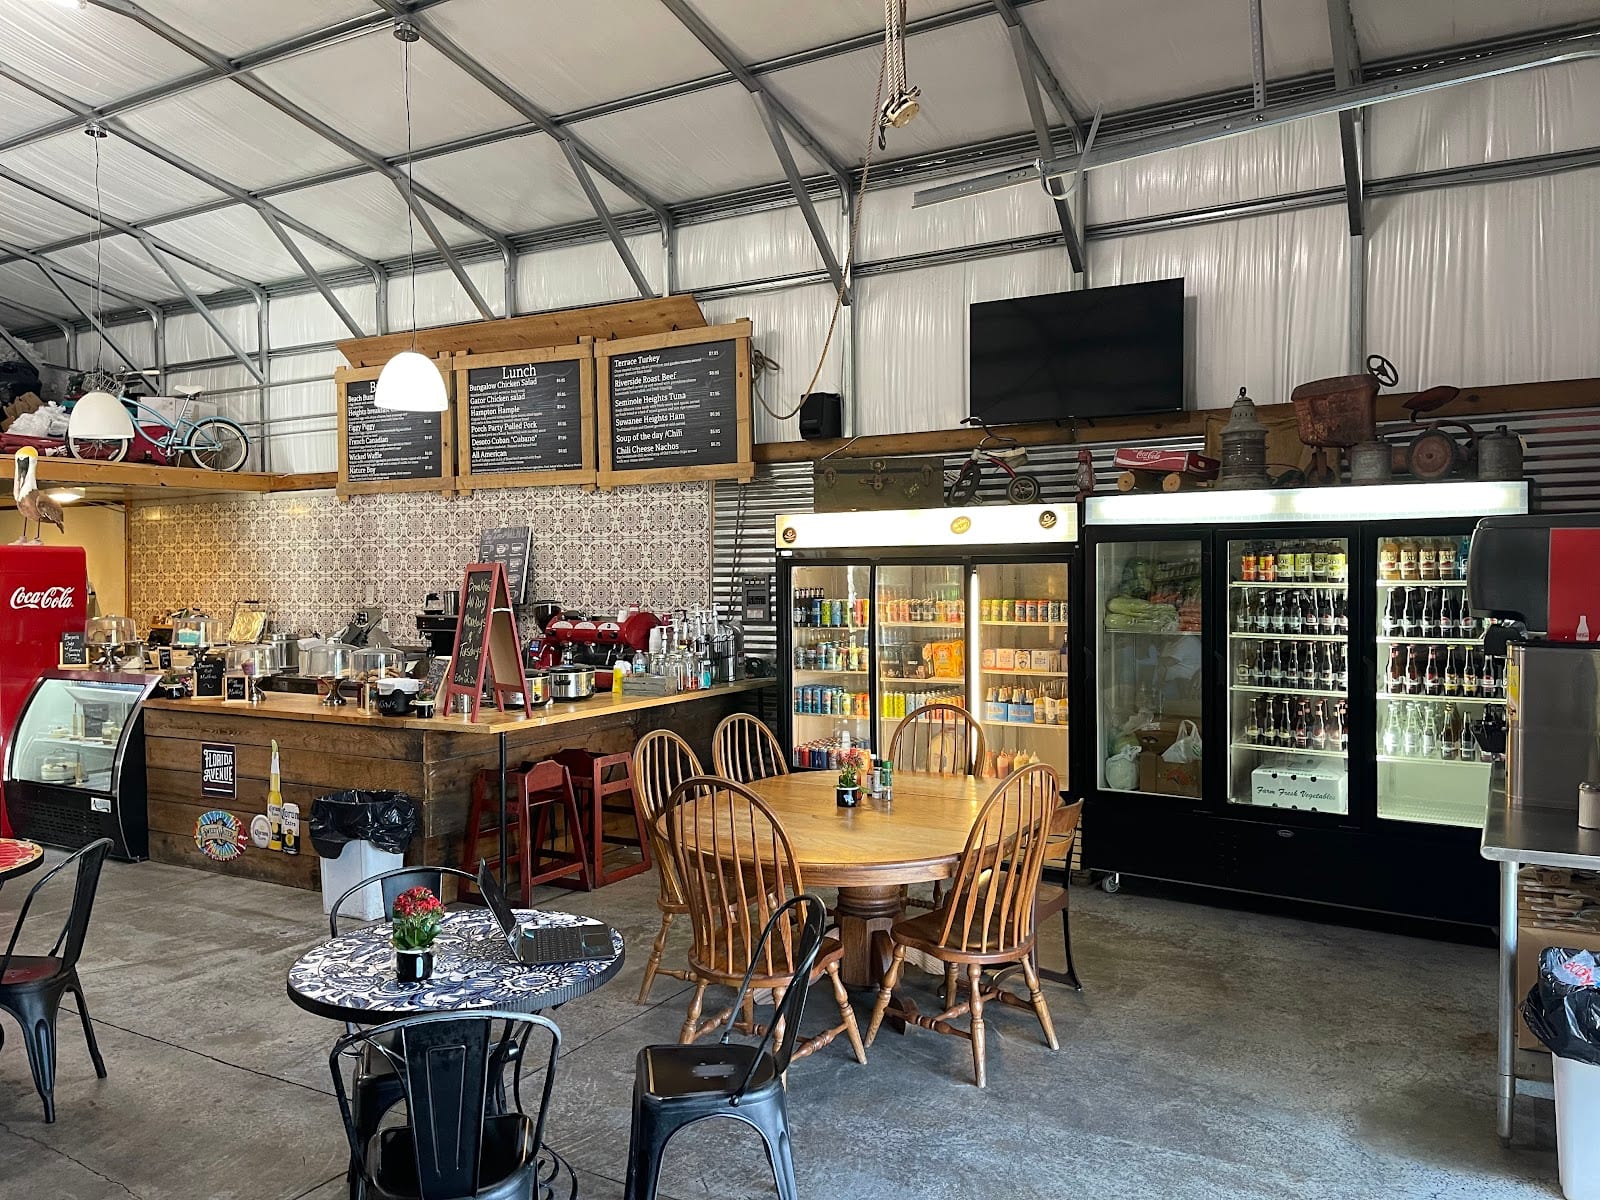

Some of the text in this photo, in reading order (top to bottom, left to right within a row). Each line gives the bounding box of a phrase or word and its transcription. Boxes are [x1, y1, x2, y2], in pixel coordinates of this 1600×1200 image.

[614, 359, 638, 367] Terrace
[638, 354, 660, 364] Turkey
[502, 364, 537, 379] Lunch
[469, 384, 497, 393] Bungalow
[497, 379, 521, 389] Chicken
[521, 377, 538, 386] Salad
[614, 371, 677, 387] Riverside Roast Beef
[469, 397, 486, 405] Gator
[486, 395, 512, 404] Chicken
[510, 393, 526, 401] salad
[615, 392, 687, 407] Seminole Heights Tuna
[470, 407, 497, 417] Hampton
[643, 414, 668, 424] Heights
[669, 412, 685, 421] Ham
[471, 425, 488, 433] Porch
[488, 424, 504, 433] Party
[523, 421, 538, 429] Pork
[471, 438, 491, 446] Desoto
[615, 434, 632, 444] Soup
[632, 432, 640, 441] of
[640, 432, 651, 440] the
[651, 430, 664, 440] day
[471, 449, 508, 459] All American
[616, 442, 680, 455] Chili Cheese Nachos
[10, 586, 75, 609] Coca-Cola
[203, 749, 233, 769] FLORIDA
[203, 767, 233, 784] AVENUE
[1256, 786, 1336, 800] Farm Fresh Vegetables
